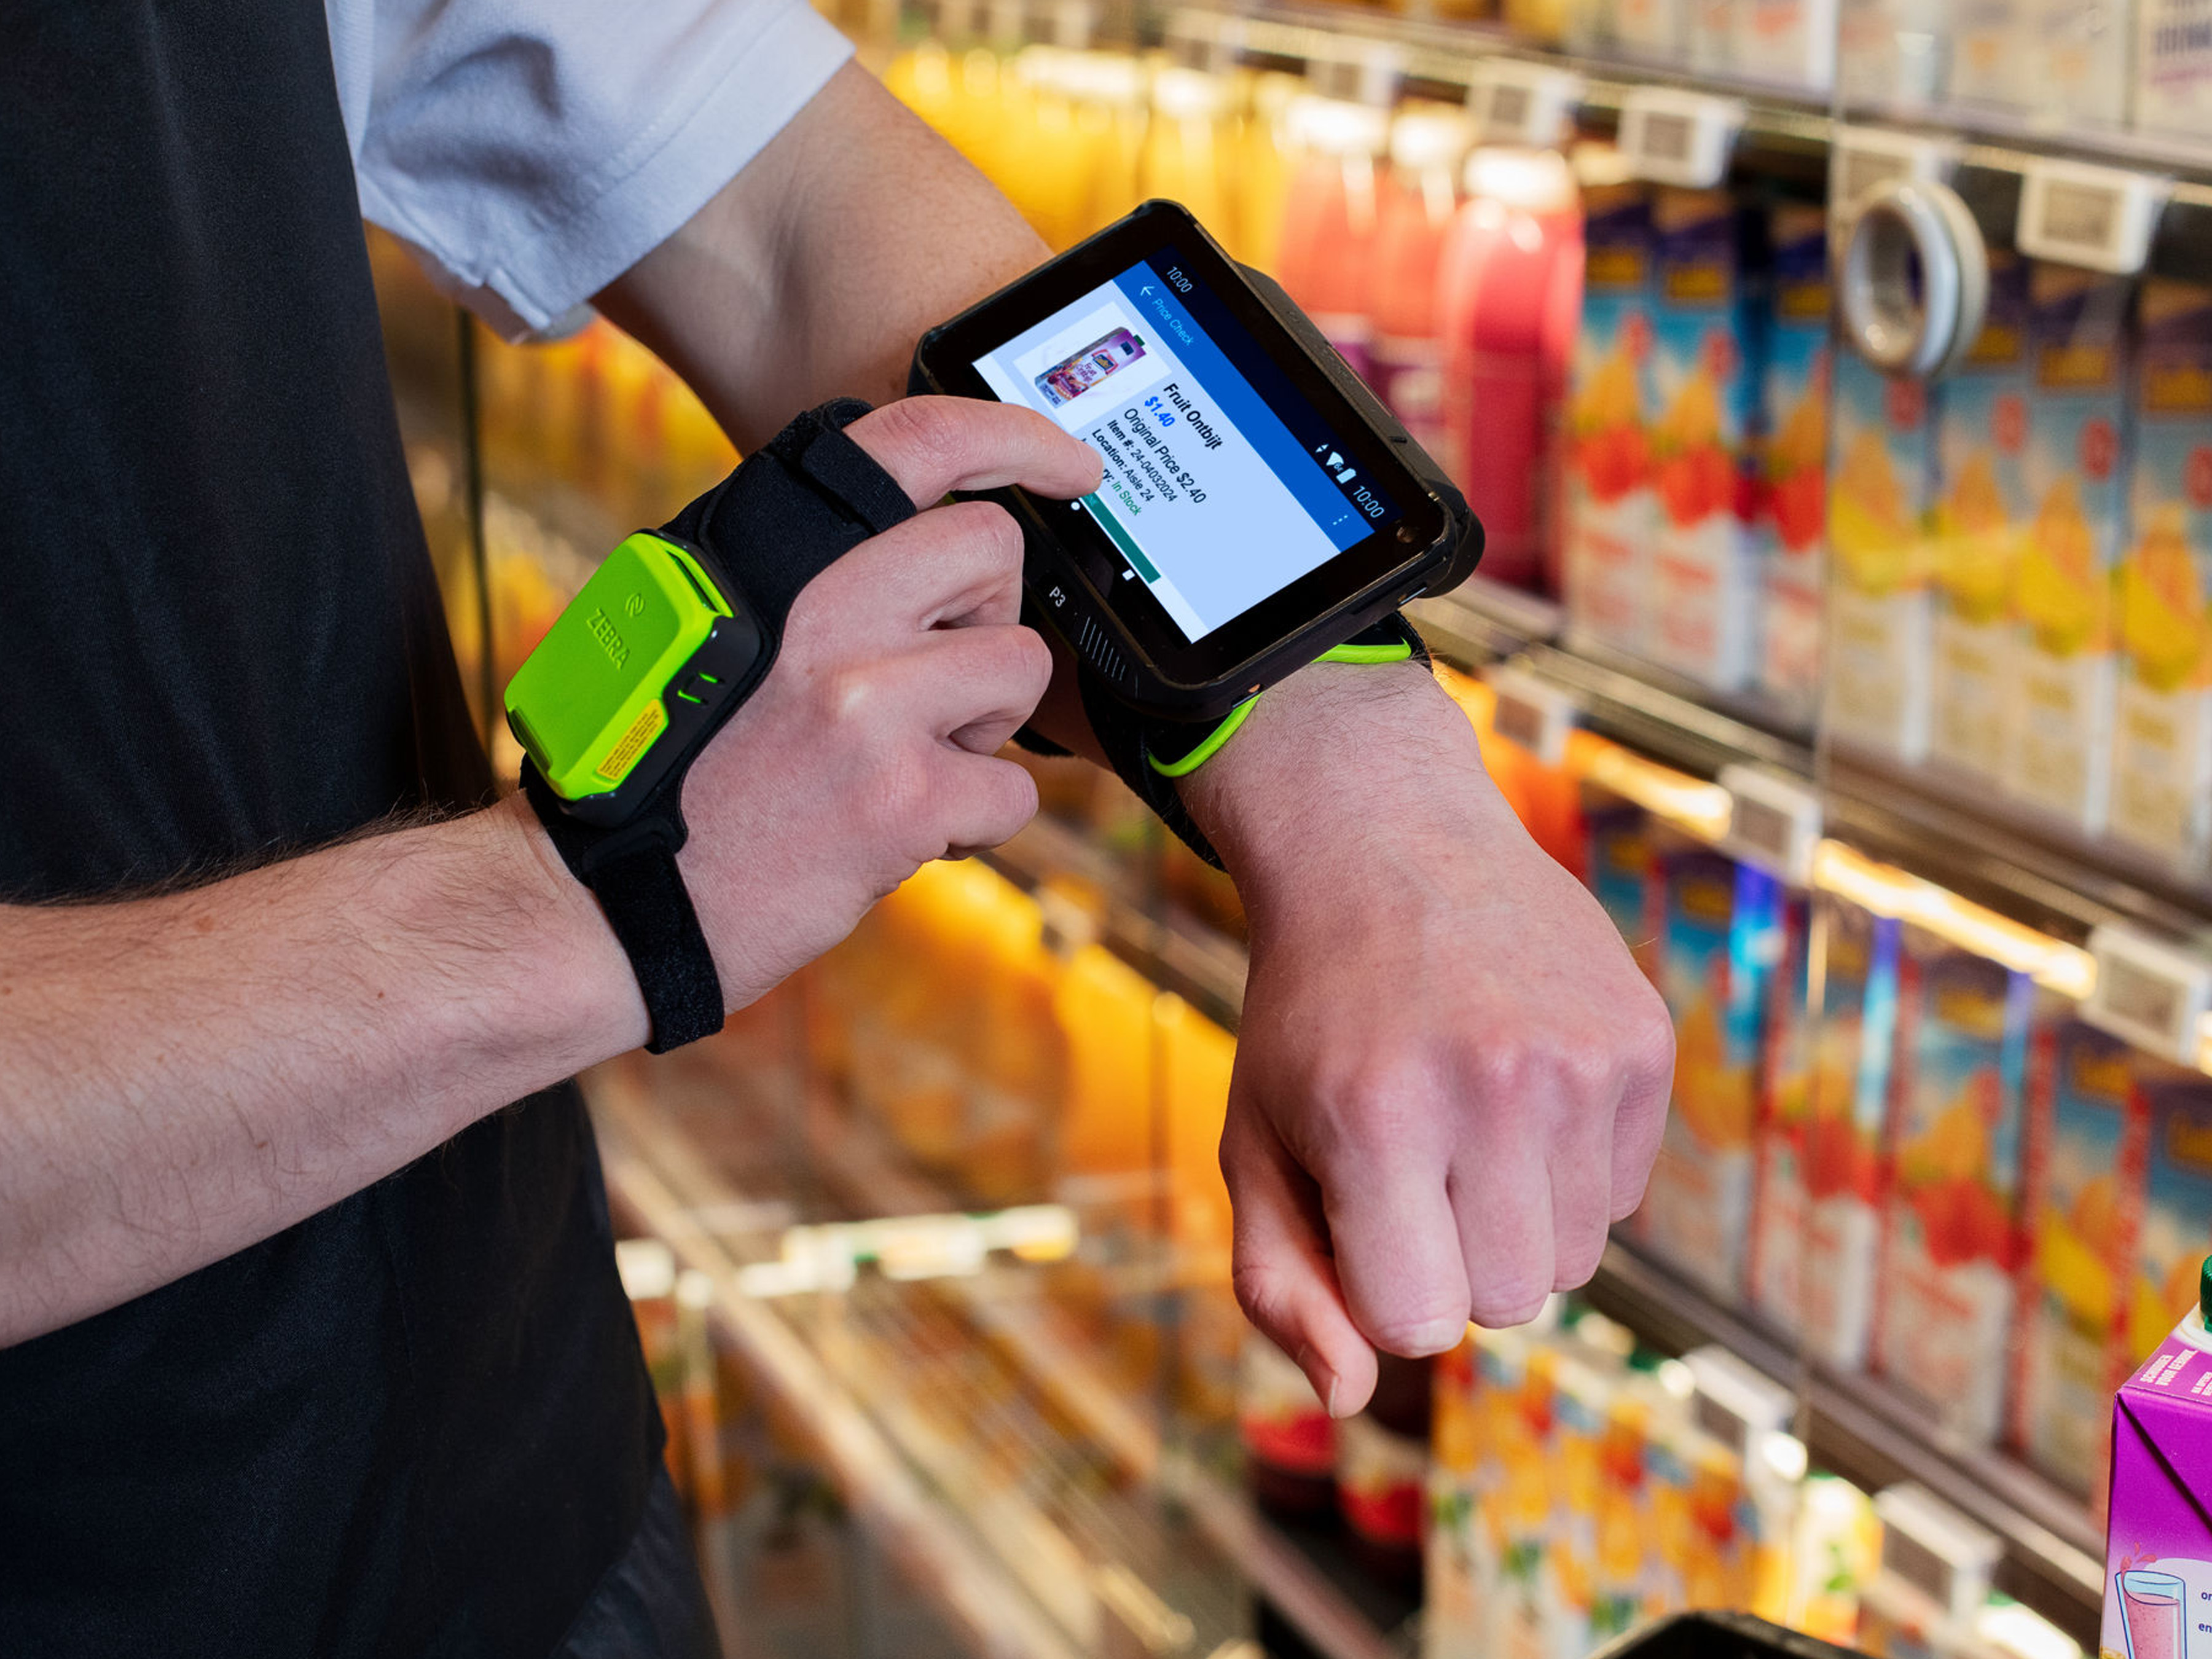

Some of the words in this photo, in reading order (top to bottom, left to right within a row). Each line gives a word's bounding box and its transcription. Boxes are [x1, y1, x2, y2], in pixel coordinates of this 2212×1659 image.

[1167, 266, 1193, 292] 10:00
[1152, 298, 1172, 320] Price
[1169, 319, 1194, 346] Check
[1144, 396, 1175, 427] $1.40
[1163, 383, 1191, 413] Fruit
[1186, 410, 1223, 450] Ontbijt
[1091, 428, 1128, 470] Location:
[1123, 468, 1144, 490] Aisle
[1140, 488, 1155, 502] 24
[1107, 419, 1127, 441] Item
[1122, 438, 1134, 451] #:
[1131, 449, 1179, 503] 24-04032024
[1124, 407, 1162, 449] Original
[1154, 445, 1180, 474] Price
[1176, 472, 1207, 504] $2.40
[1119, 491, 1142, 516] Stock
[1353, 485, 1385, 518] 10:00
[1049, 586, 1065, 607] P3
[586, 606, 630, 670] ZEBRA
